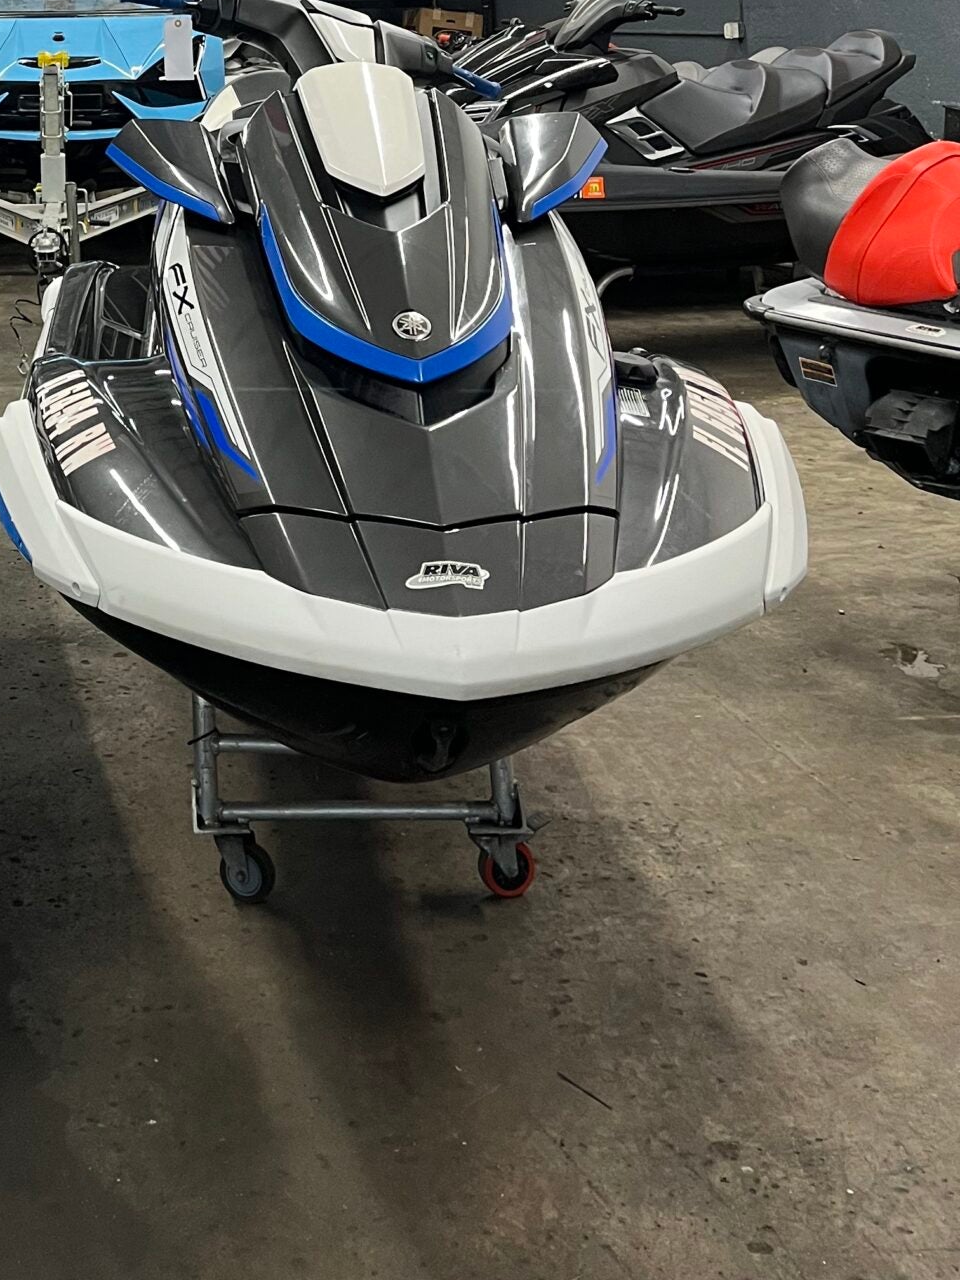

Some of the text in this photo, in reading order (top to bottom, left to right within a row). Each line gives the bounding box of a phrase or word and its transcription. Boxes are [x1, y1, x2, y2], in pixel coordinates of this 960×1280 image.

[167, 263, 208, 368] FX CRUISER
[55, 422, 117, 477] RW
[692, 424, 749, 472] FL
[424, 564, 480, 577] RIVA
